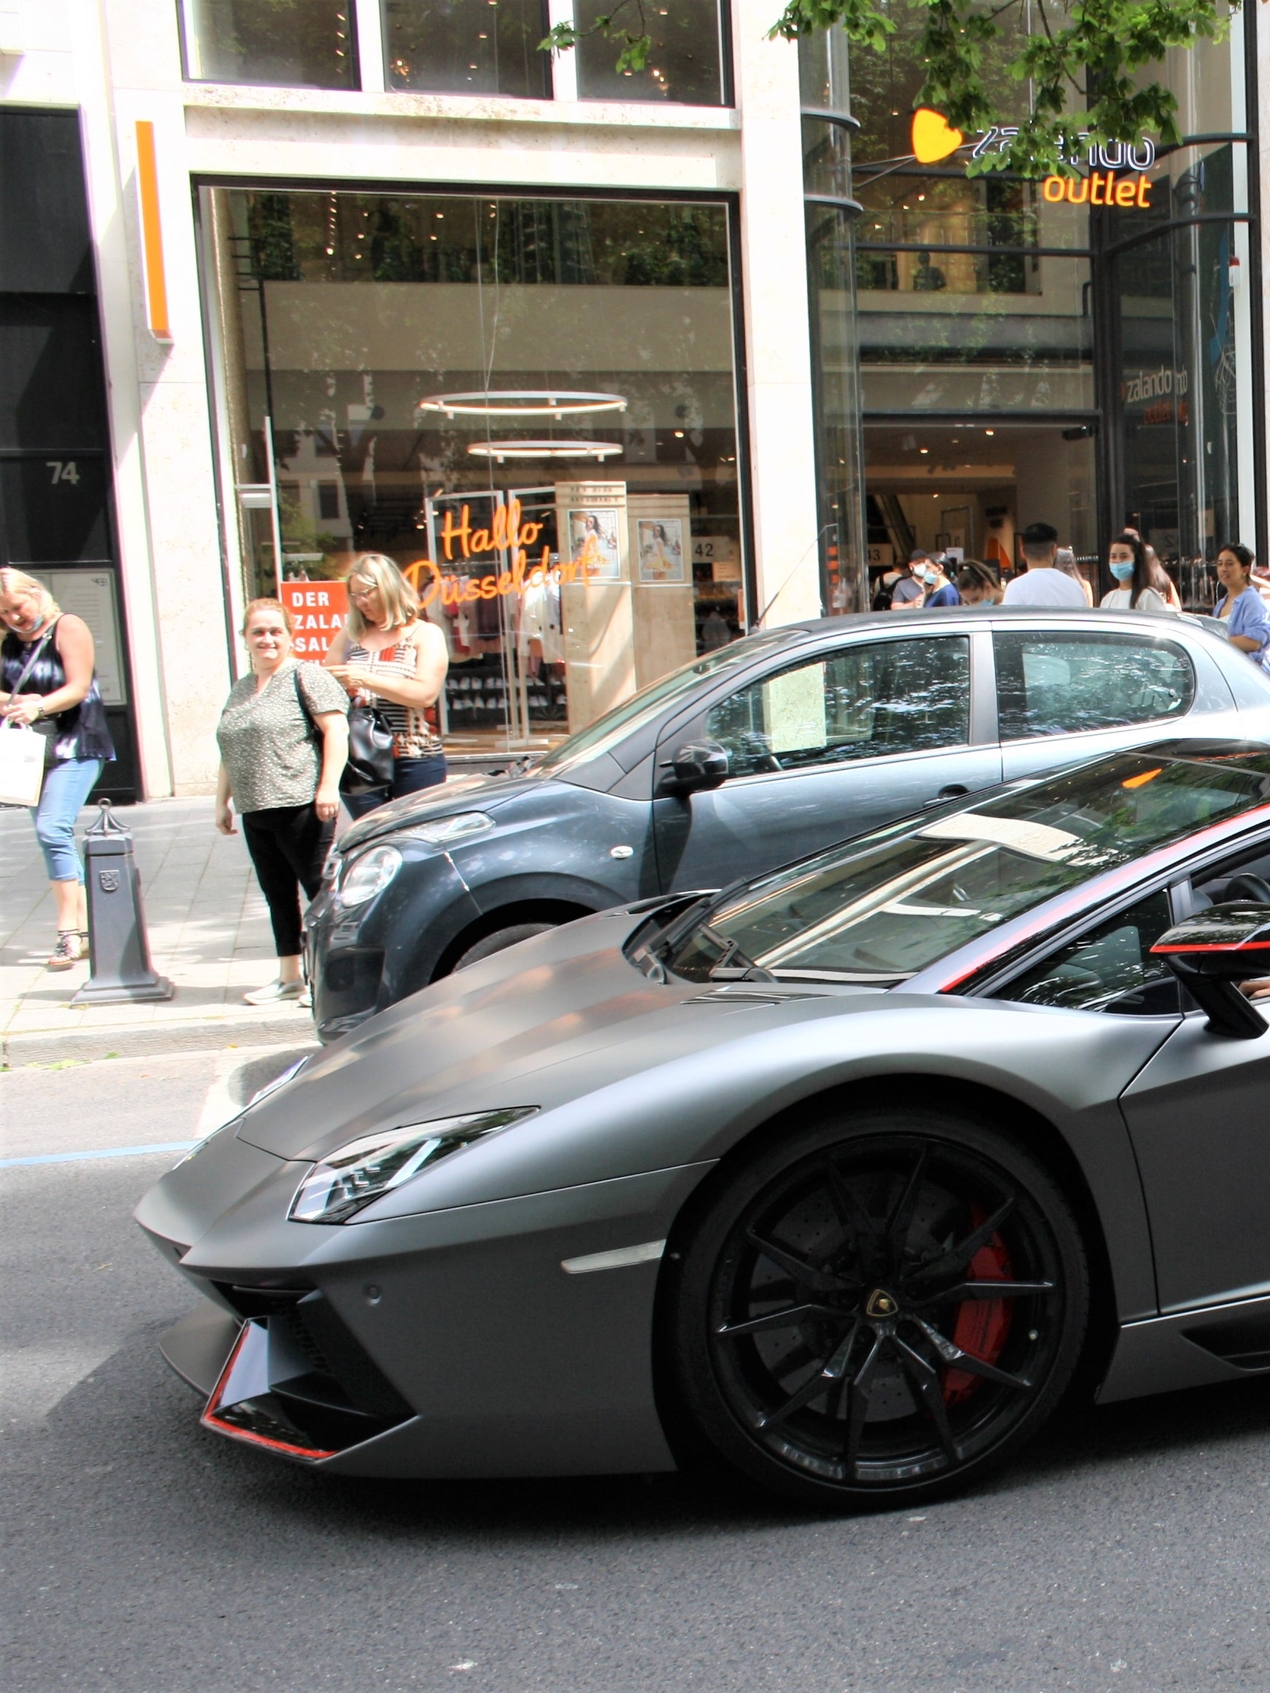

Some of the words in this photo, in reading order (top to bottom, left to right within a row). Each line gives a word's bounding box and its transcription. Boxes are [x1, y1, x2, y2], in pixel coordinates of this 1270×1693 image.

[1043, 171, 1152, 208] outlet
[1127, 364, 1172, 403] zalando
[46, 461, 80, 485] 74
[441, 499, 543, 560] Hallo
[695, 542, 714, 557] 42
[403, 537, 608, 610] Düsseldorf
[292, 591, 329, 607] DER
[294, 613, 348, 630] ZALA
